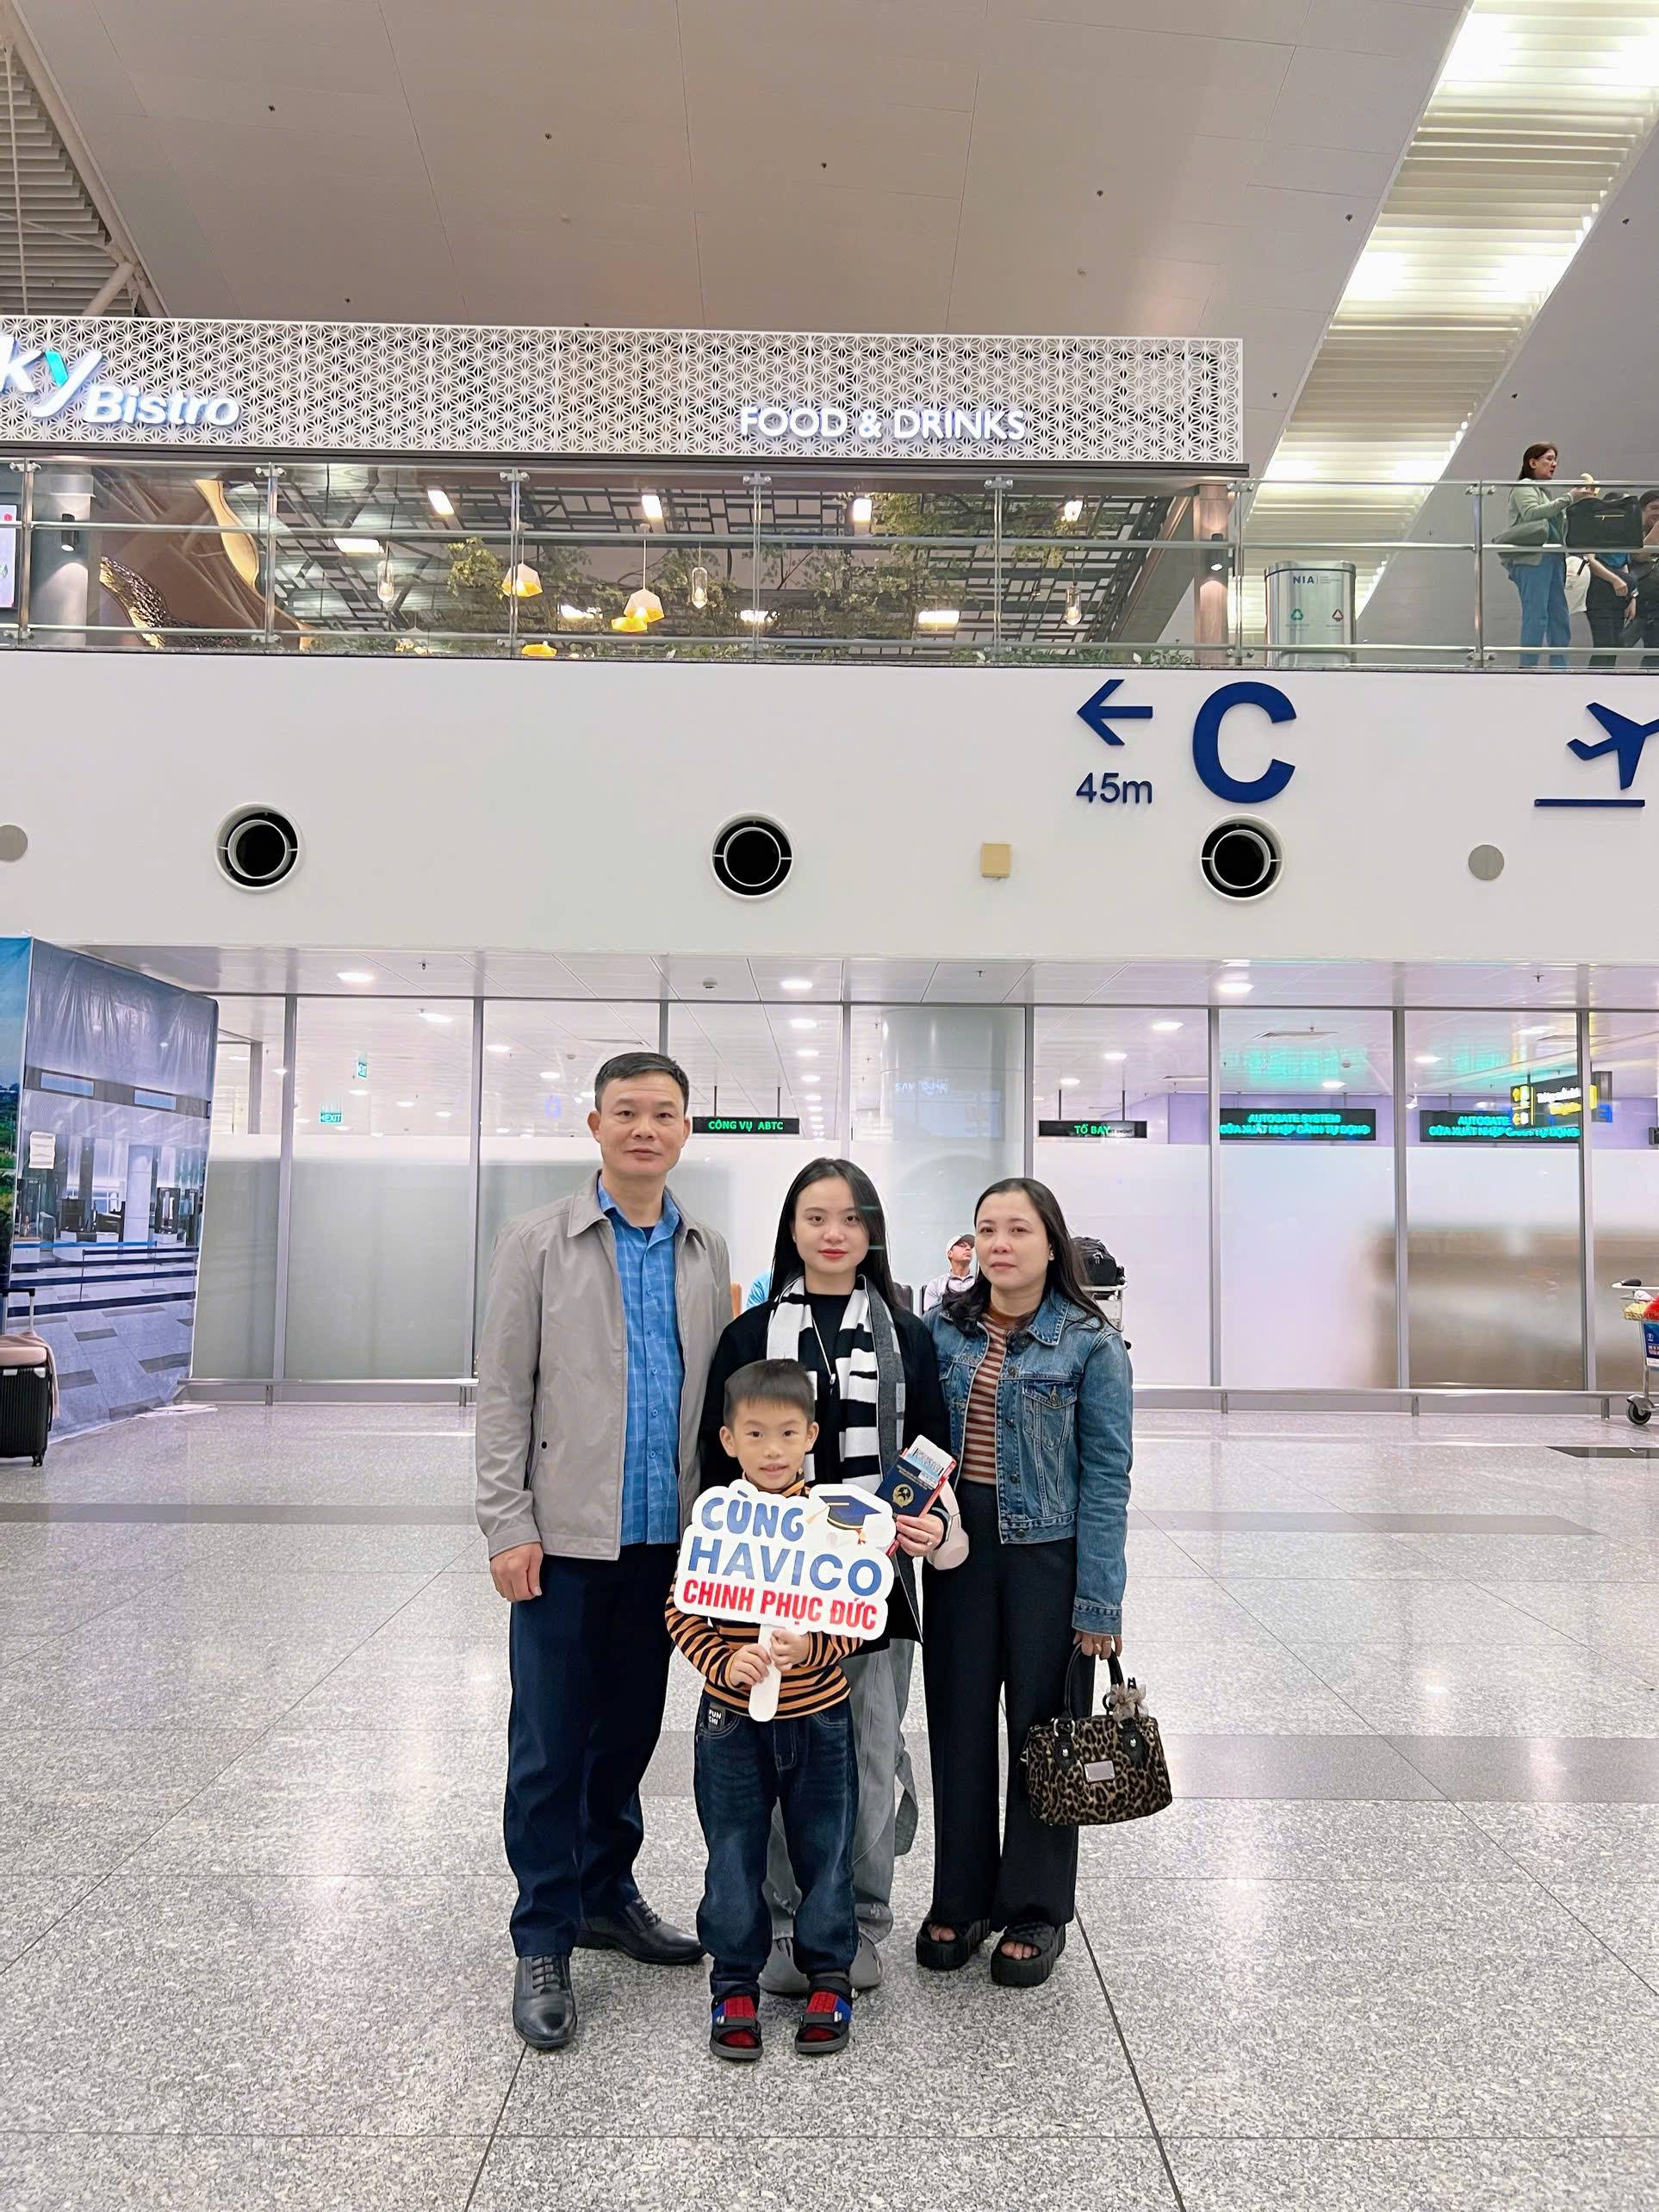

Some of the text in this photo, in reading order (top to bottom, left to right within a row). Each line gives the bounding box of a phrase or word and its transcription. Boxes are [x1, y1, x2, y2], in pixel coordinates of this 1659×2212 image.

[86, 385, 240, 426] Bistro
[740, 407, 1024, 440] FOOD & DRINKS
[1293, 575, 1314, 584] NIA
[1192, 681, 1296, 804] C
[1076, 772, 1153, 804] 45m
[708, 1119, 784, 1132] CÔNG VỤ ABTC
[1090, 1125, 1111, 1134] BAY
[701, 1490, 805, 1542] CÙNG
[688, 1536, 882, 1596] HAVICO
[683, 1579, 878, 1630] CHINH PHỤC ĐỨC
